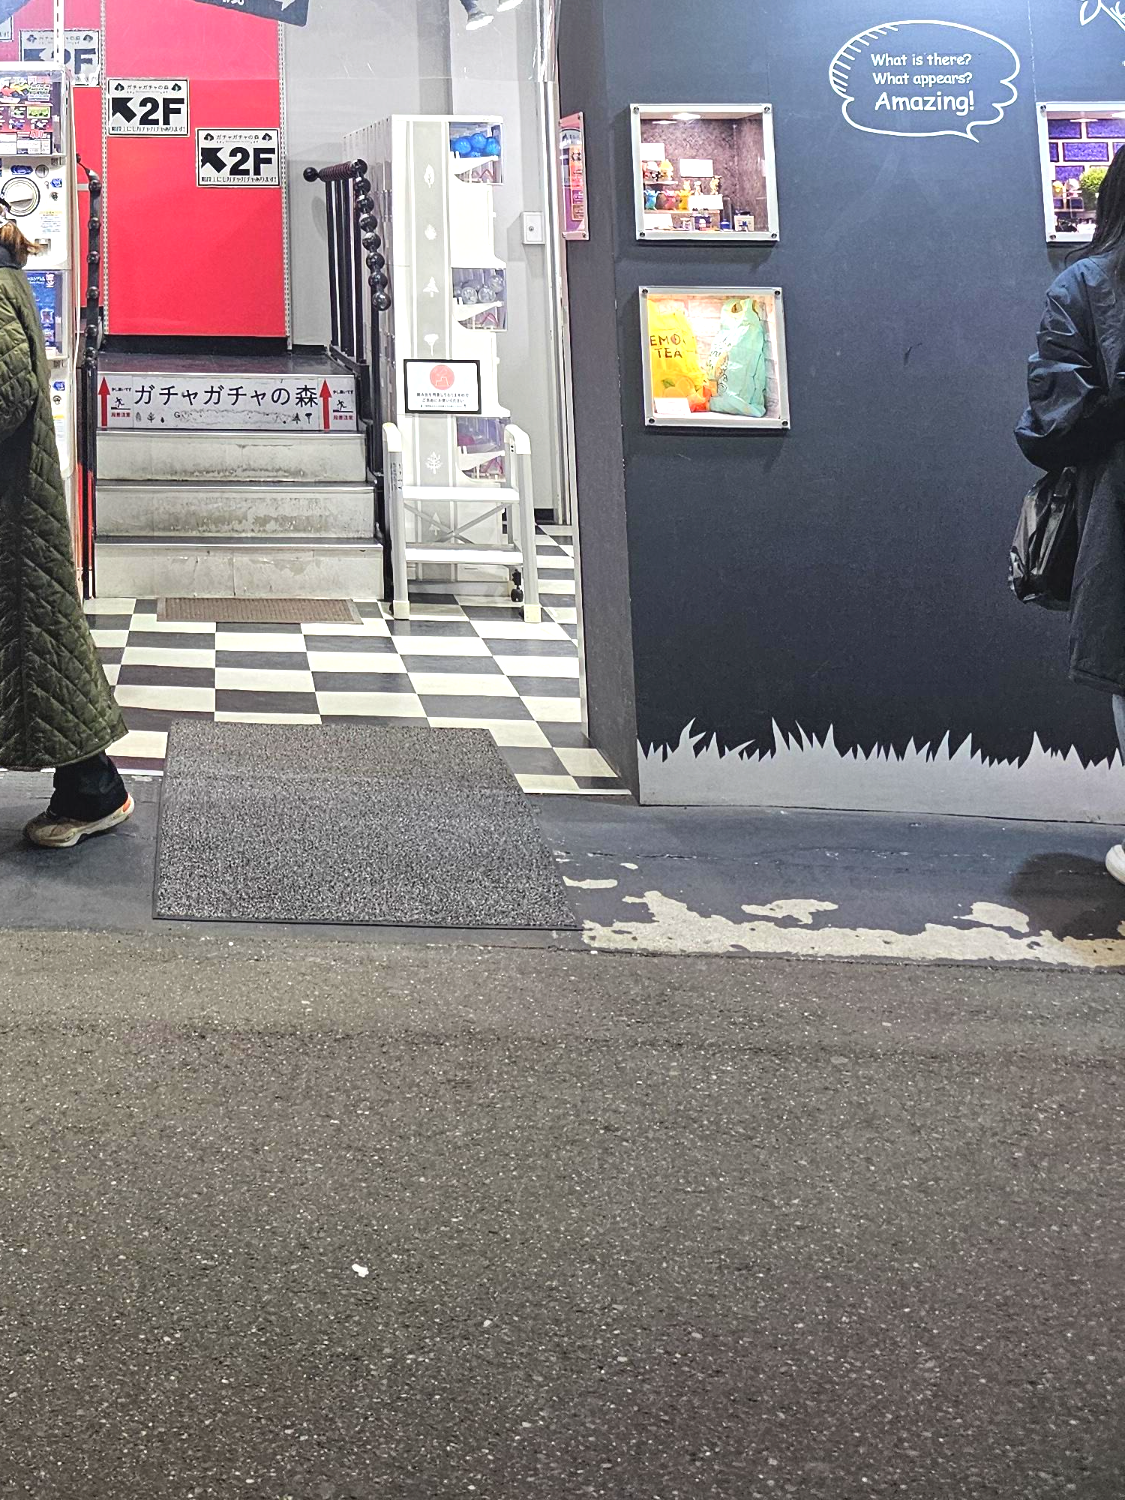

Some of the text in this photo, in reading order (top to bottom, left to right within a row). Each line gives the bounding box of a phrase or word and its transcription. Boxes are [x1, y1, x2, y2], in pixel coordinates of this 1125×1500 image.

[871, 53, 972, 66] What is there?
[872, 72, 973, 87] What appears?
[139, 97, 185, 126] 2F
[875, 90, 974, 116] Amazing!
[229, 146, 276, 176] 2F
[655, 347, 683, 359] TEA
[134, 384, 319, 408] ガチャガチャの森
